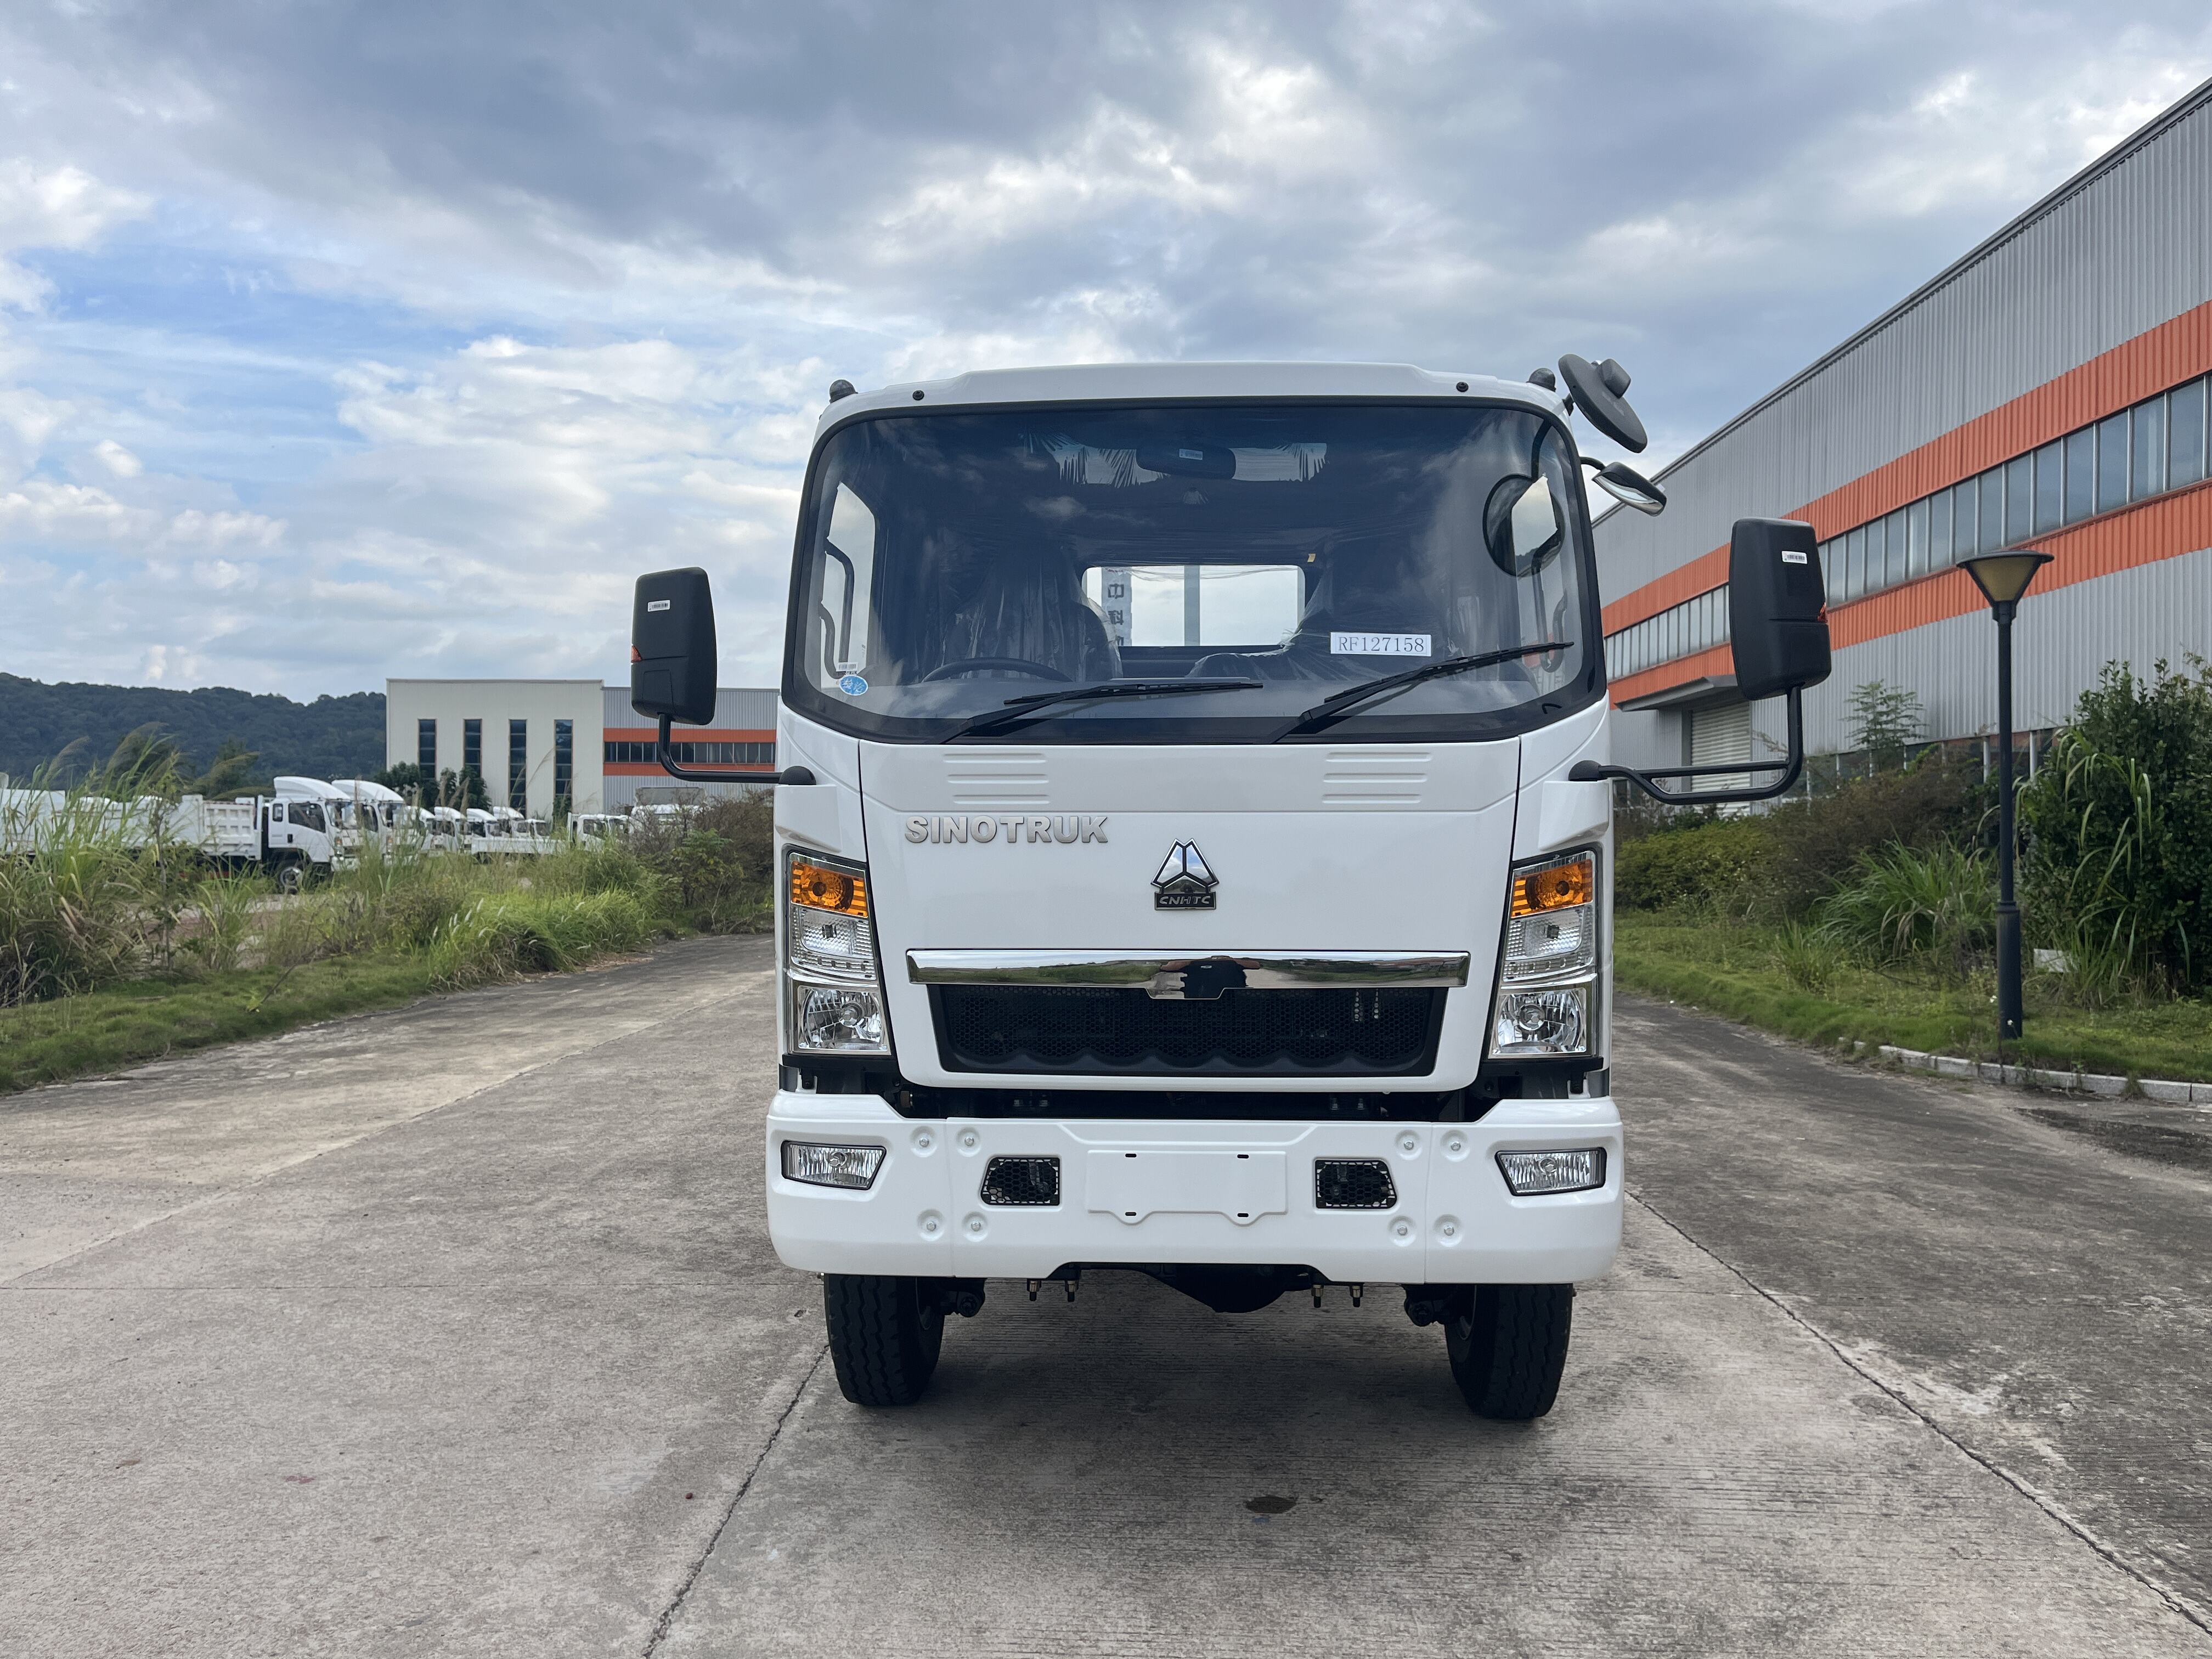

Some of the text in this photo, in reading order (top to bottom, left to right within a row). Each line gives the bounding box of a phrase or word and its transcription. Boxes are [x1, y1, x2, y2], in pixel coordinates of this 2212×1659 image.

[1338, 636, 1425, 653] RF127158
[904, 815, 1109, 844] SINOTRUK
[1159, 895, 1211, 905] CNHTC
